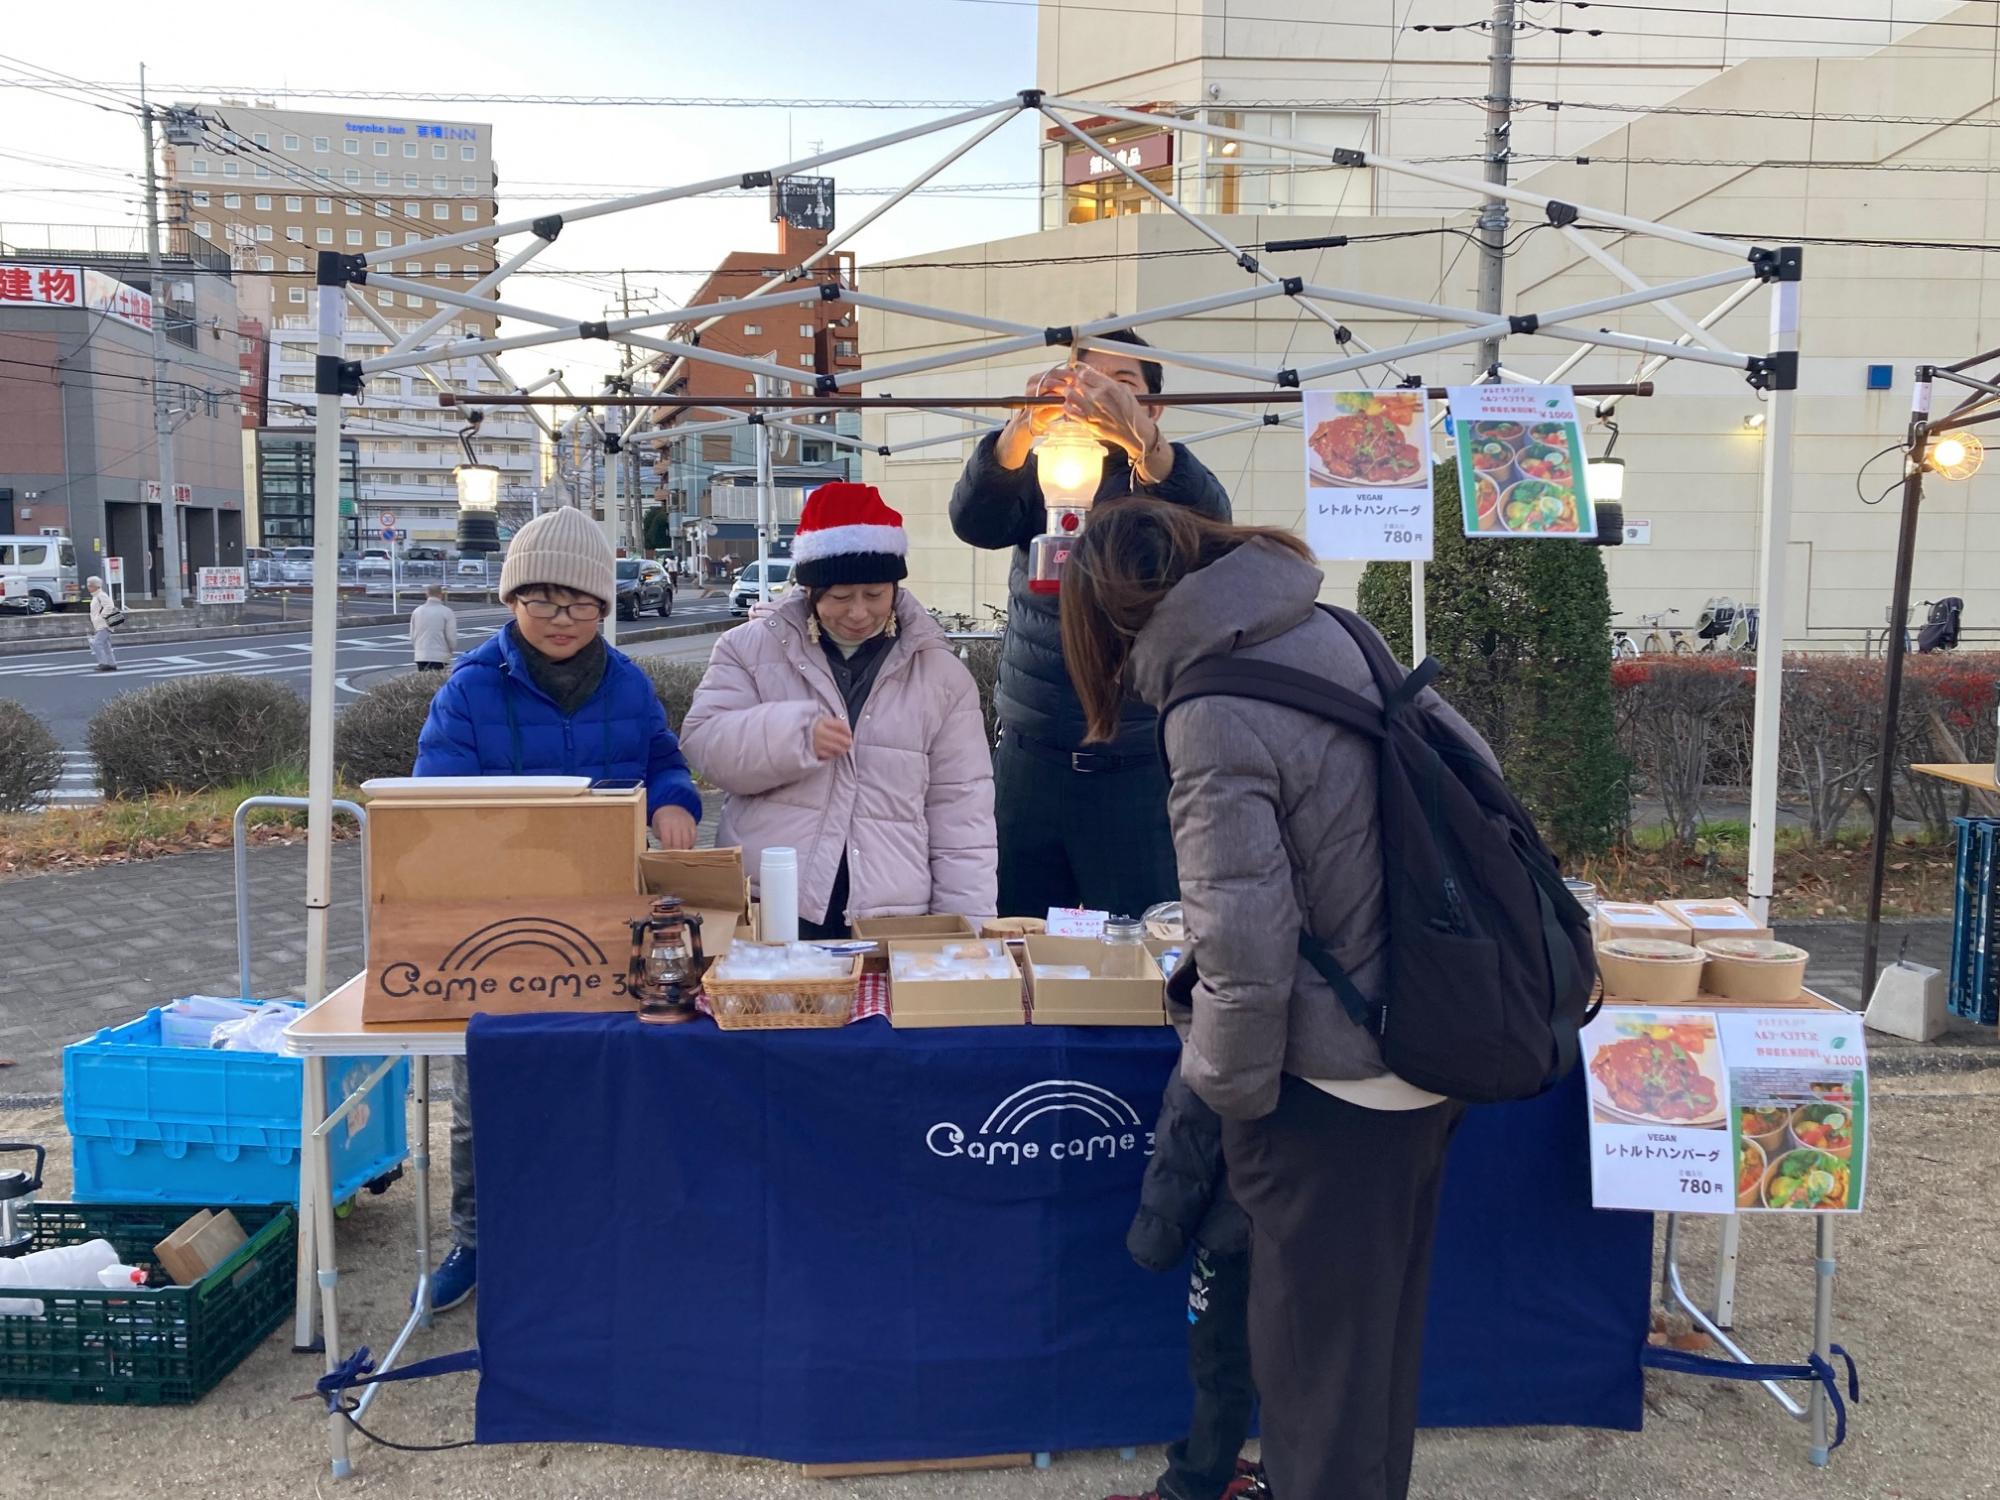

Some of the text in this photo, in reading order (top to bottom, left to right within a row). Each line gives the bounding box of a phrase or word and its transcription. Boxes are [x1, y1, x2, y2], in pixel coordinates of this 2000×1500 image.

[0, 268, 75, 303] 建物
[1319, 504, 1421, 516] レトルトハンバーグ
[509, 973, 602, 998] came
[611, 973, 628, 996] 3
[1050, 1133, 1135, 1161] came
[1648, 1133, 1677, 1142] VEGAN
[1605, 1143, 1720, 1162] レトルトハンバーグ
